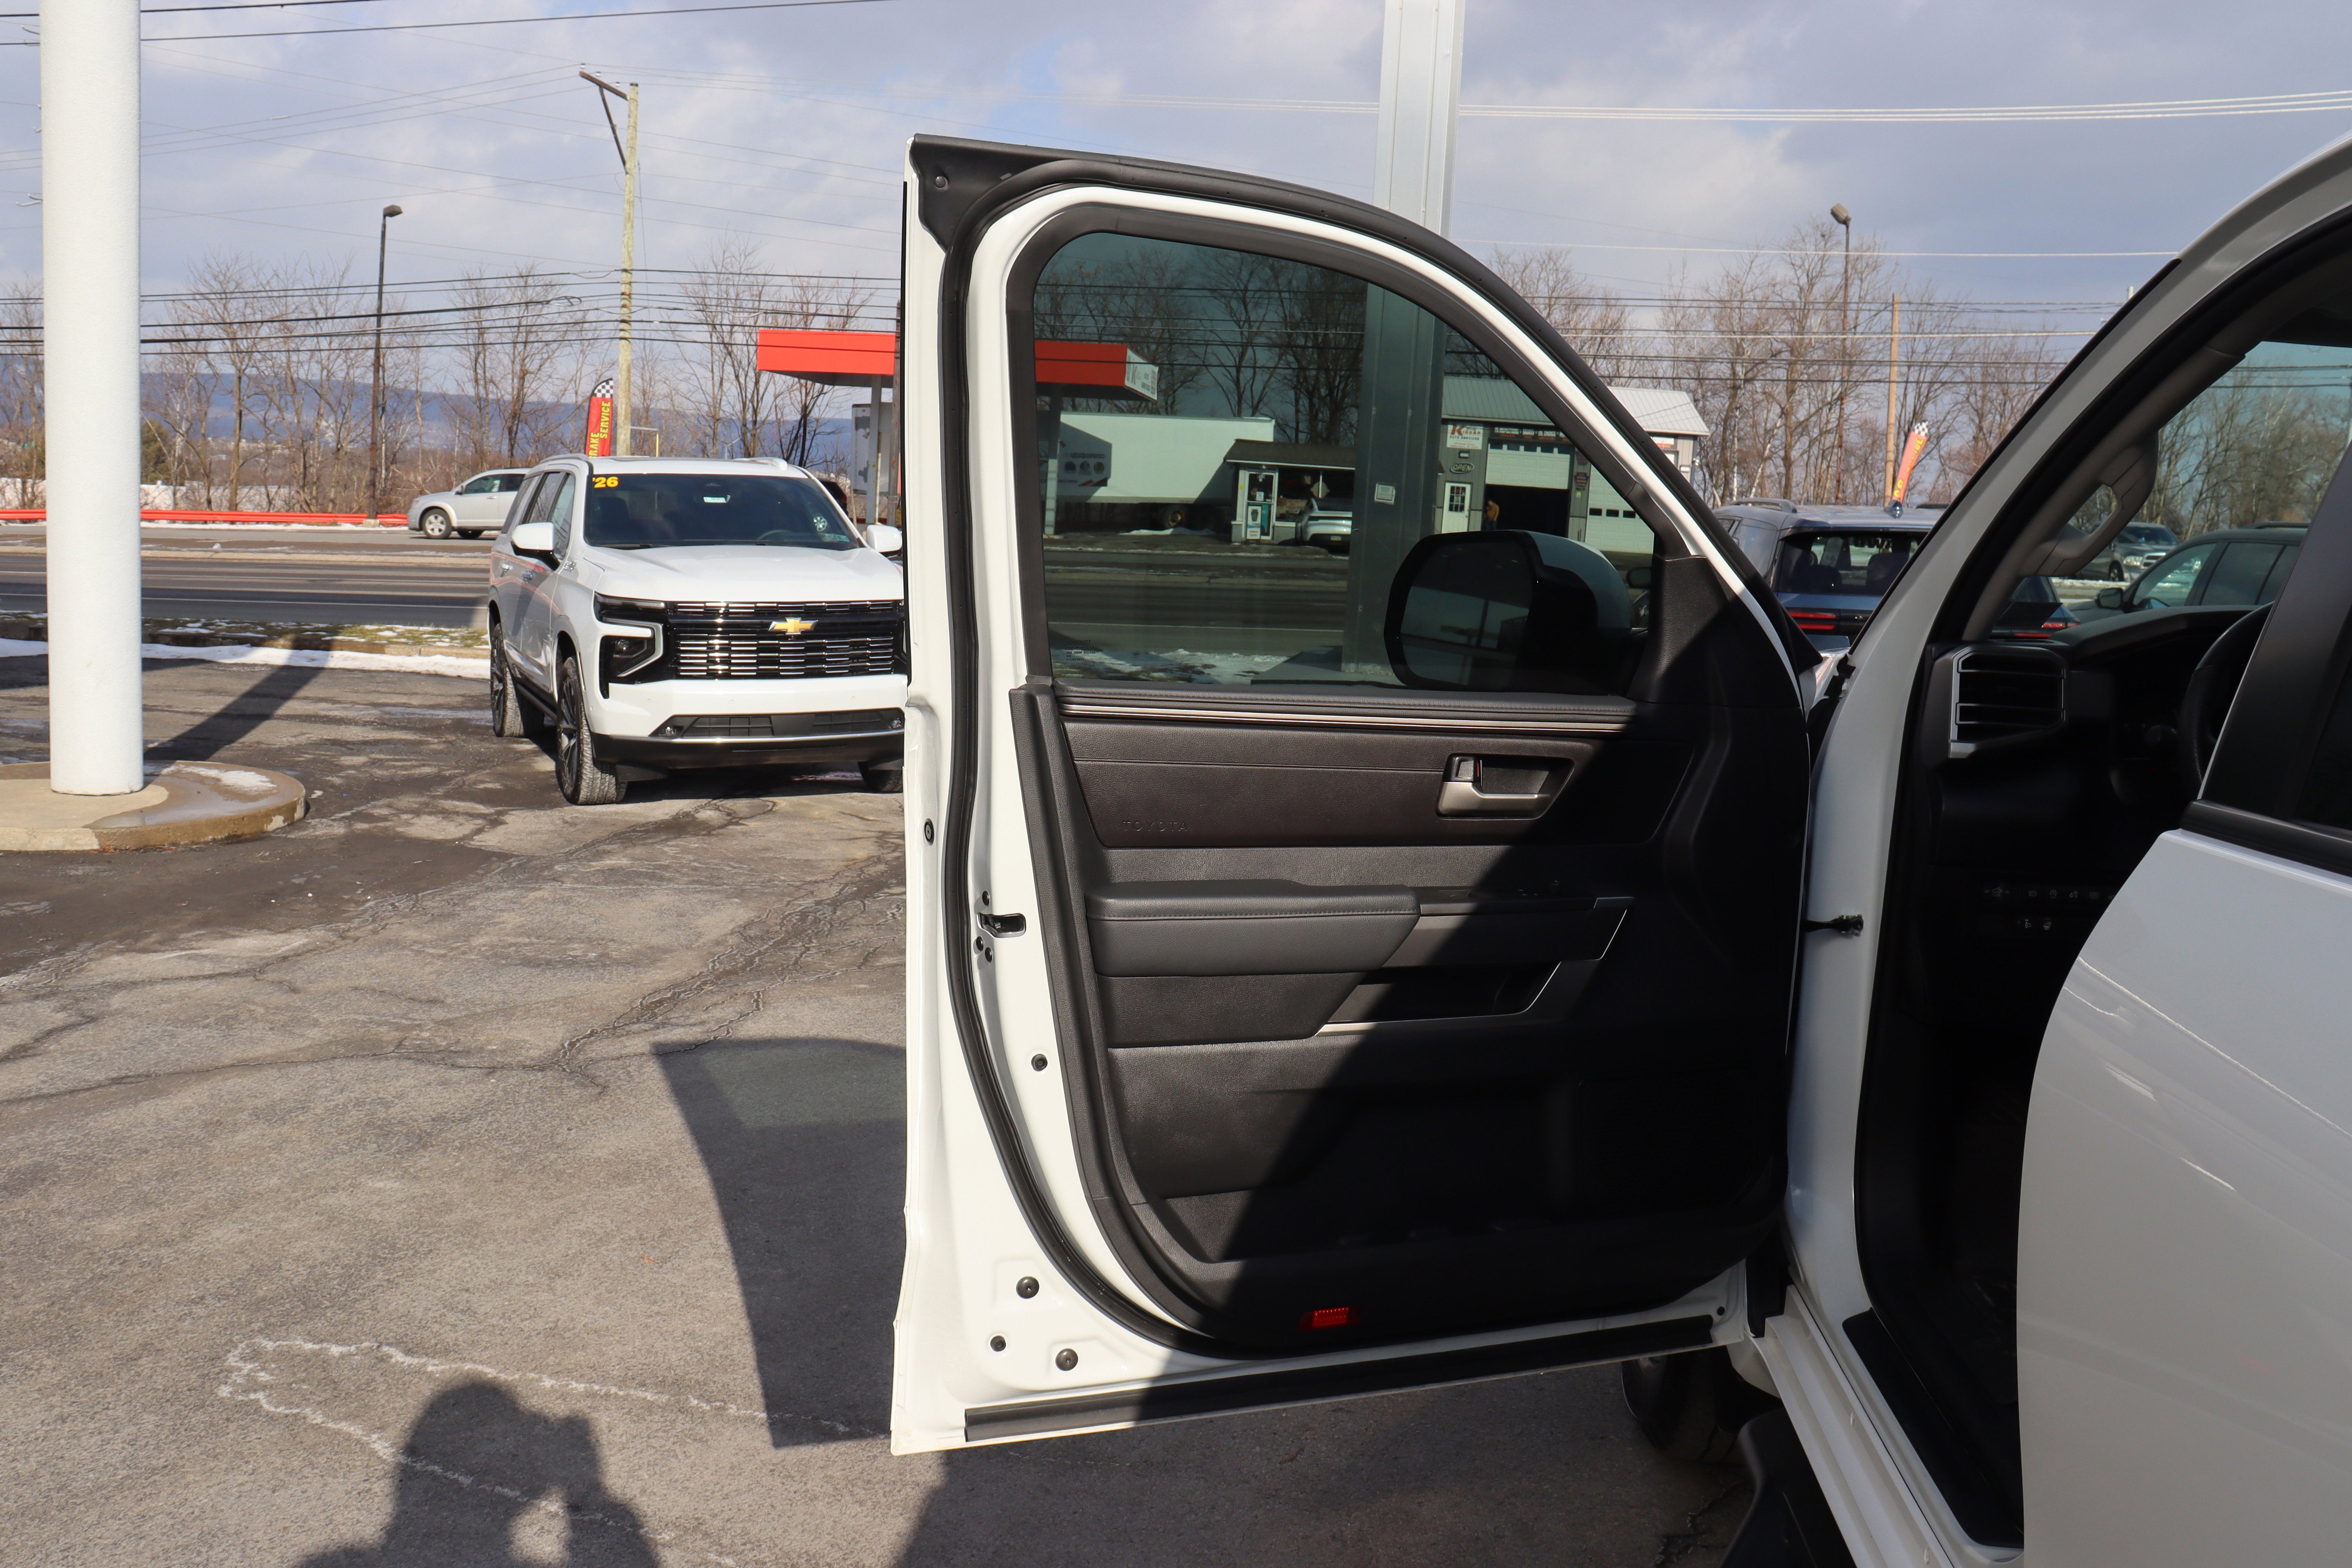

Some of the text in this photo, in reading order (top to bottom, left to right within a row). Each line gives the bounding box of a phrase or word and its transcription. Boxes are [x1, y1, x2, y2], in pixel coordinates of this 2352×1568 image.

[600, 401, 611, 439] SERVICE
[588, 432, 599, 457] RAKE
[1123, 821, 1188, 831] TOYOTA
